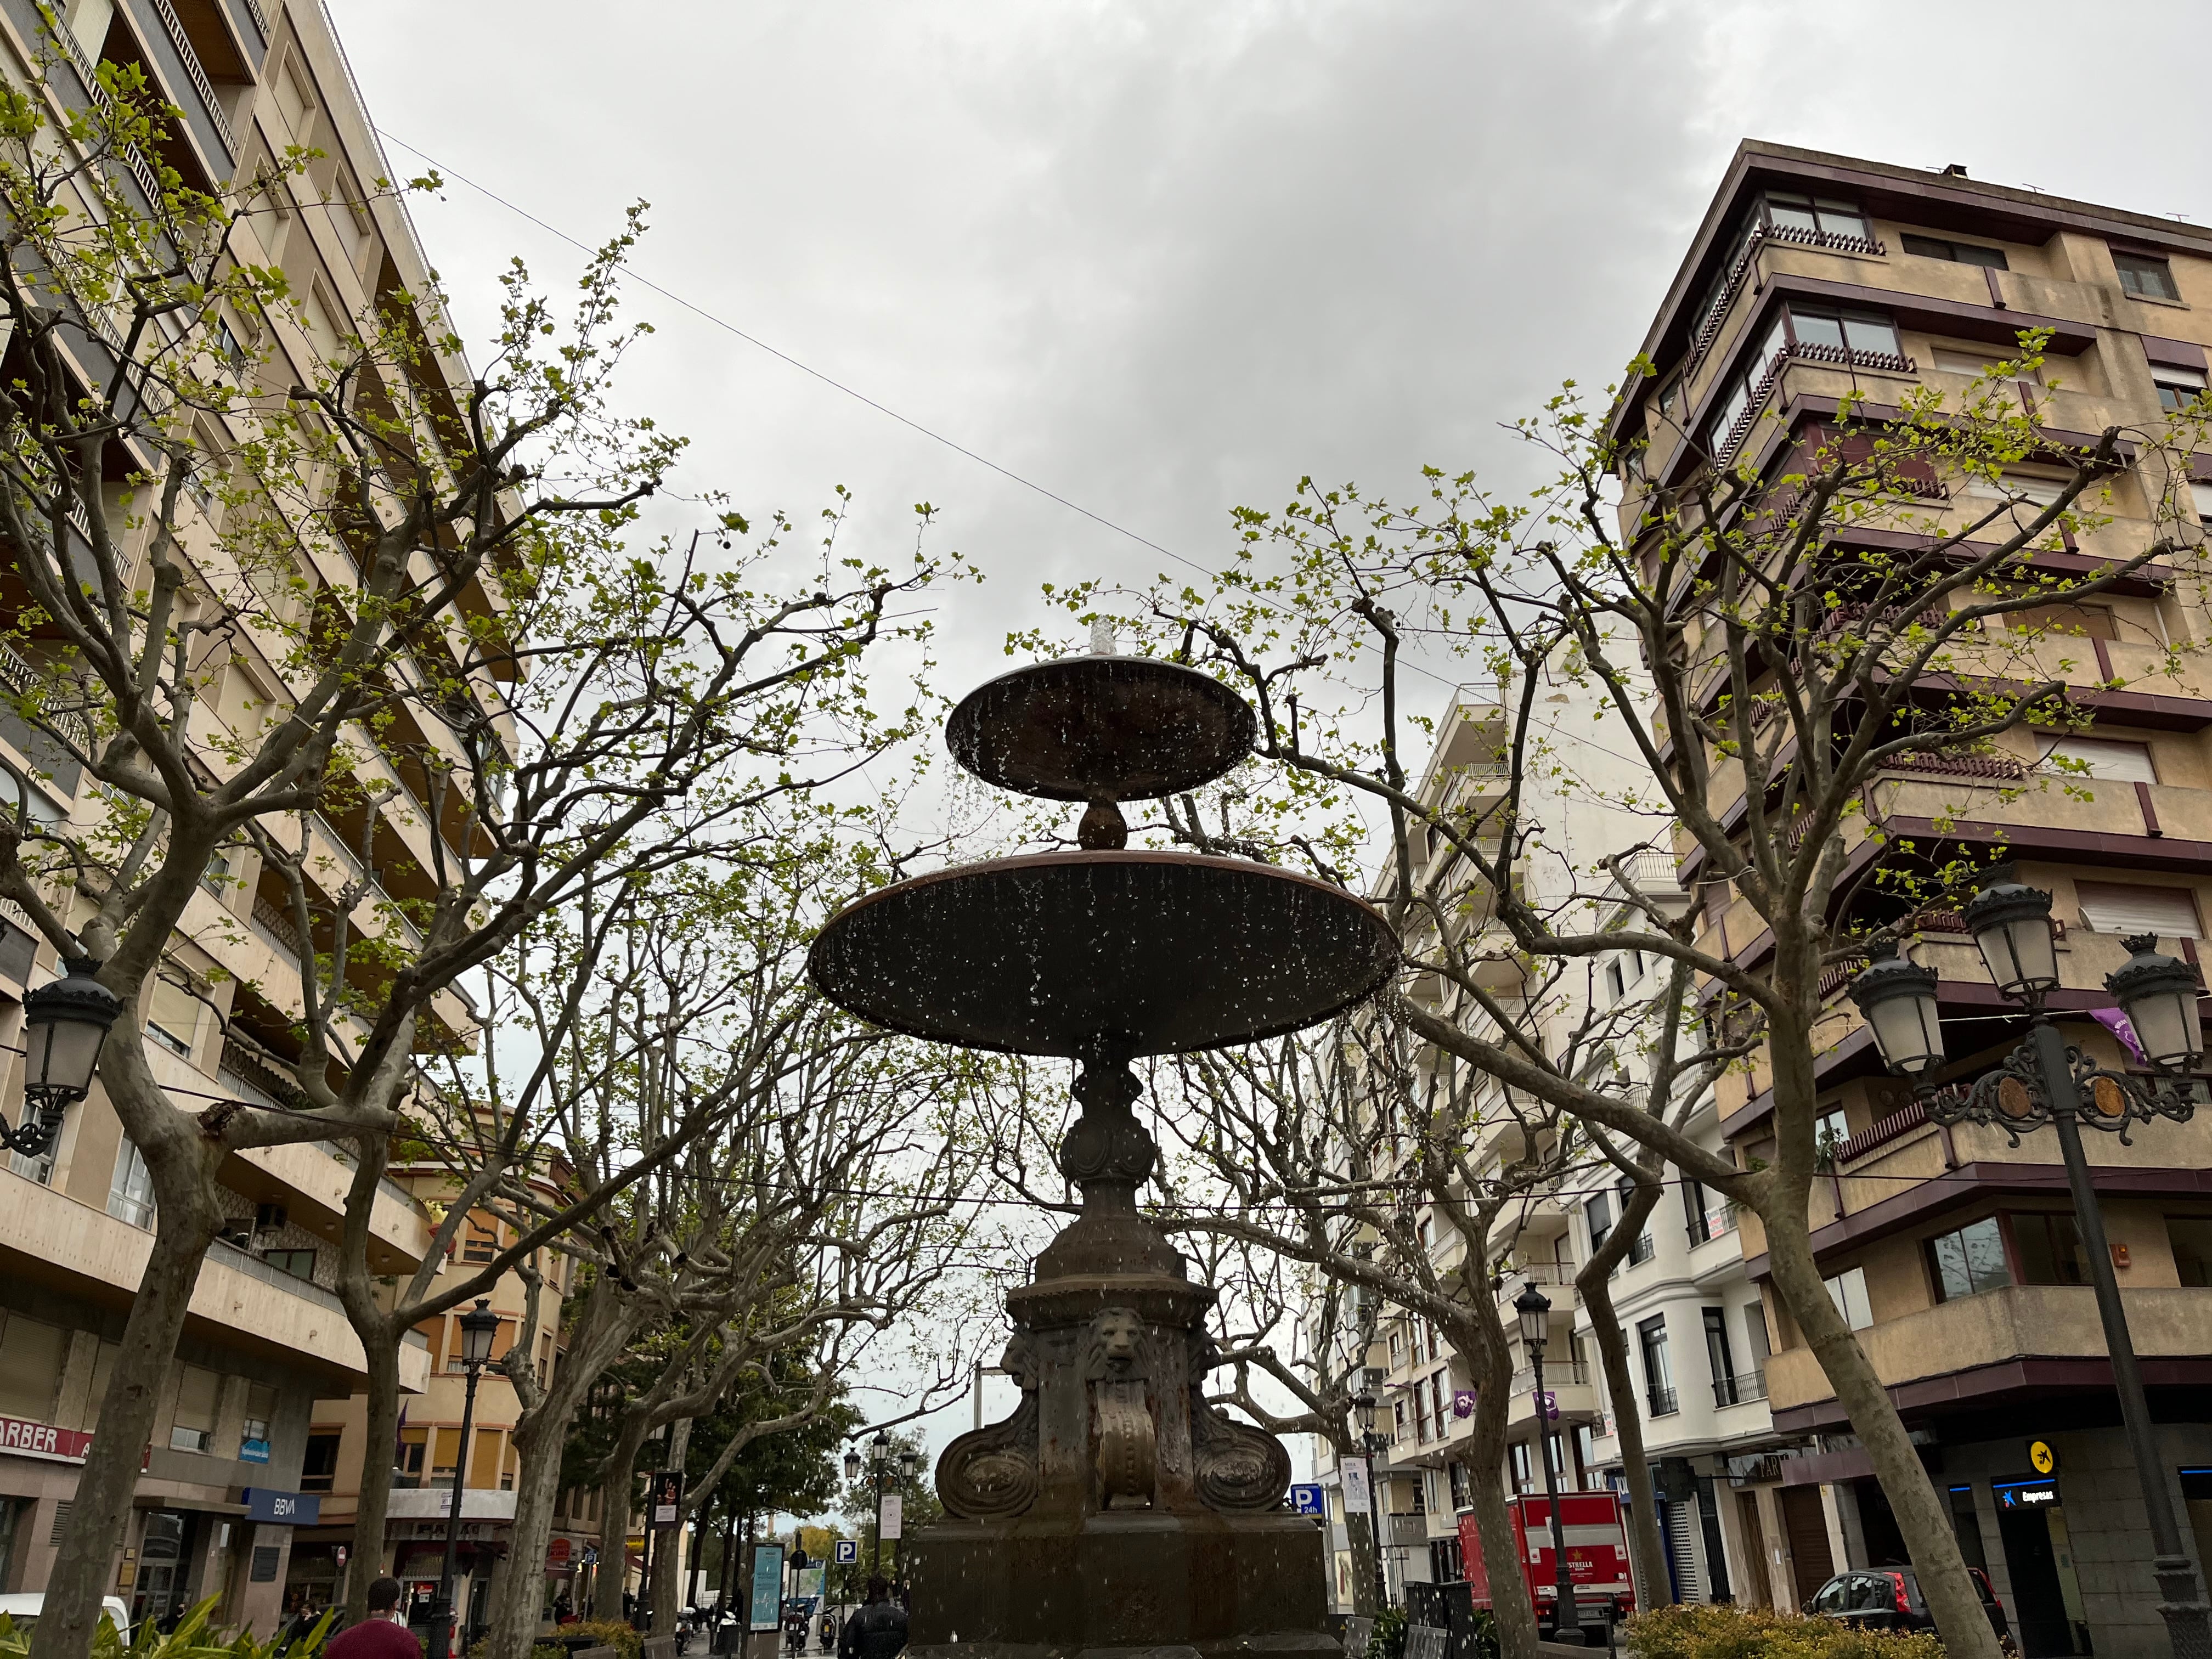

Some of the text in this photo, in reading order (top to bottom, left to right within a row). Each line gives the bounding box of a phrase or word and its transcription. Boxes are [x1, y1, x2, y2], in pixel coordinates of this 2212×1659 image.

[1295, 1489, 1312, 1513] P
[2022, 1491, 2053, 1503] Empresas
[274, 1498, 295, 1515] BBVA
[839, 1543, 853, 1561] P
